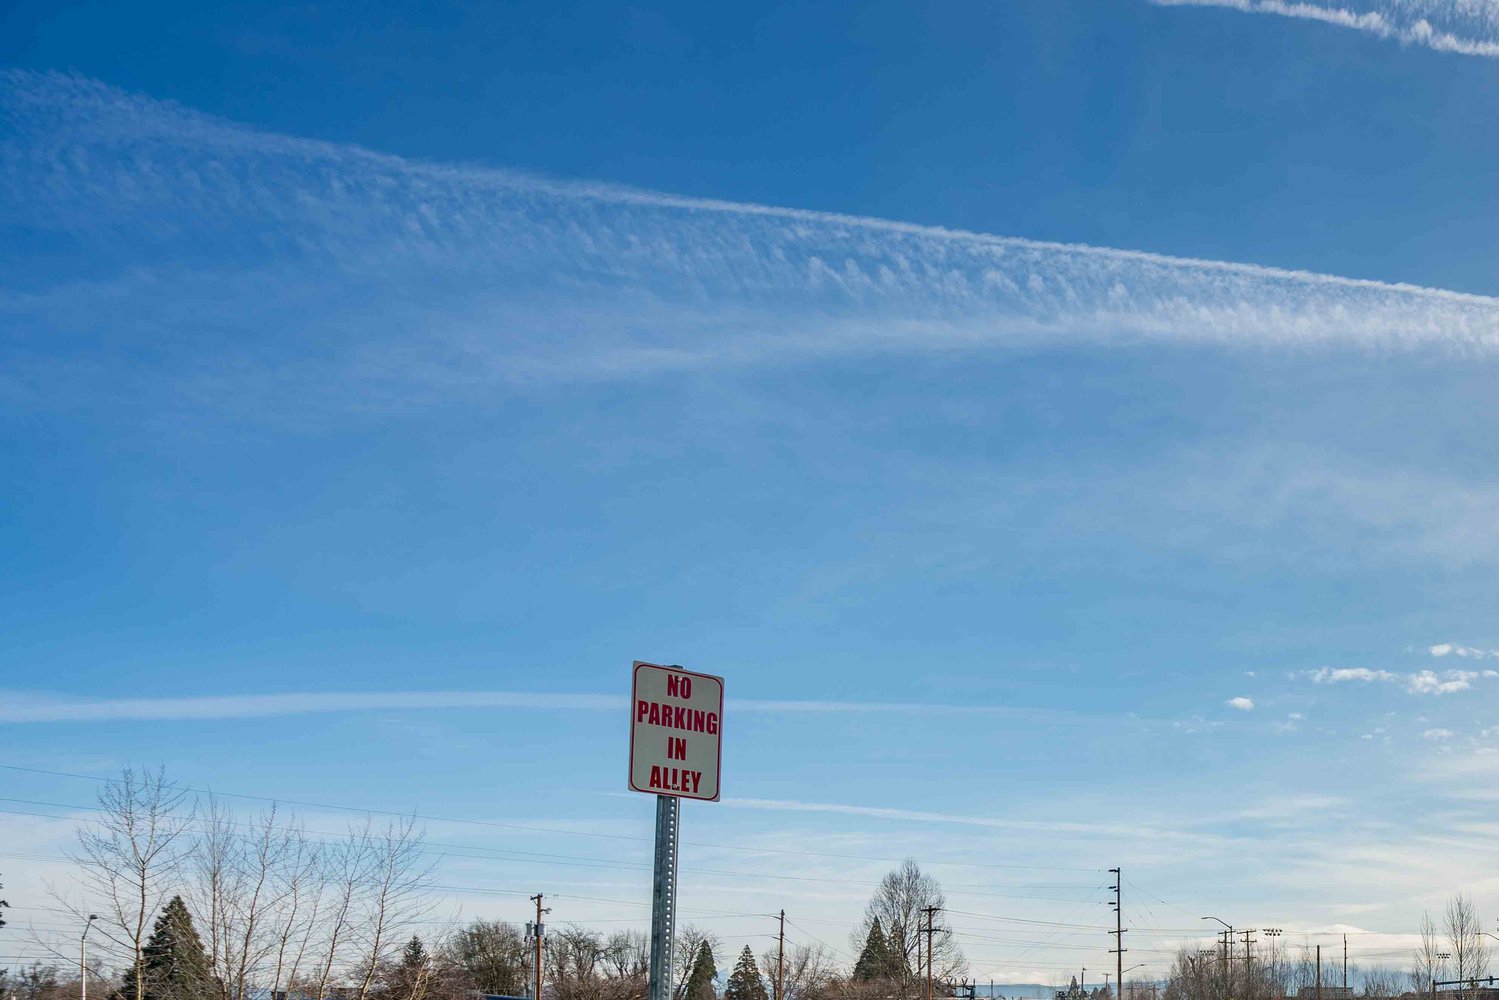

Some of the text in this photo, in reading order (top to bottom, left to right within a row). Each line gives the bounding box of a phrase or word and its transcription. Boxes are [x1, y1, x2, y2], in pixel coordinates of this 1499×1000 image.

[667, 674, 692, 699] NO
[637, 700, 718, 735] PARKING
[667, 736, 687, 761] IN
[649, 765, 702, 793] ALLEY
